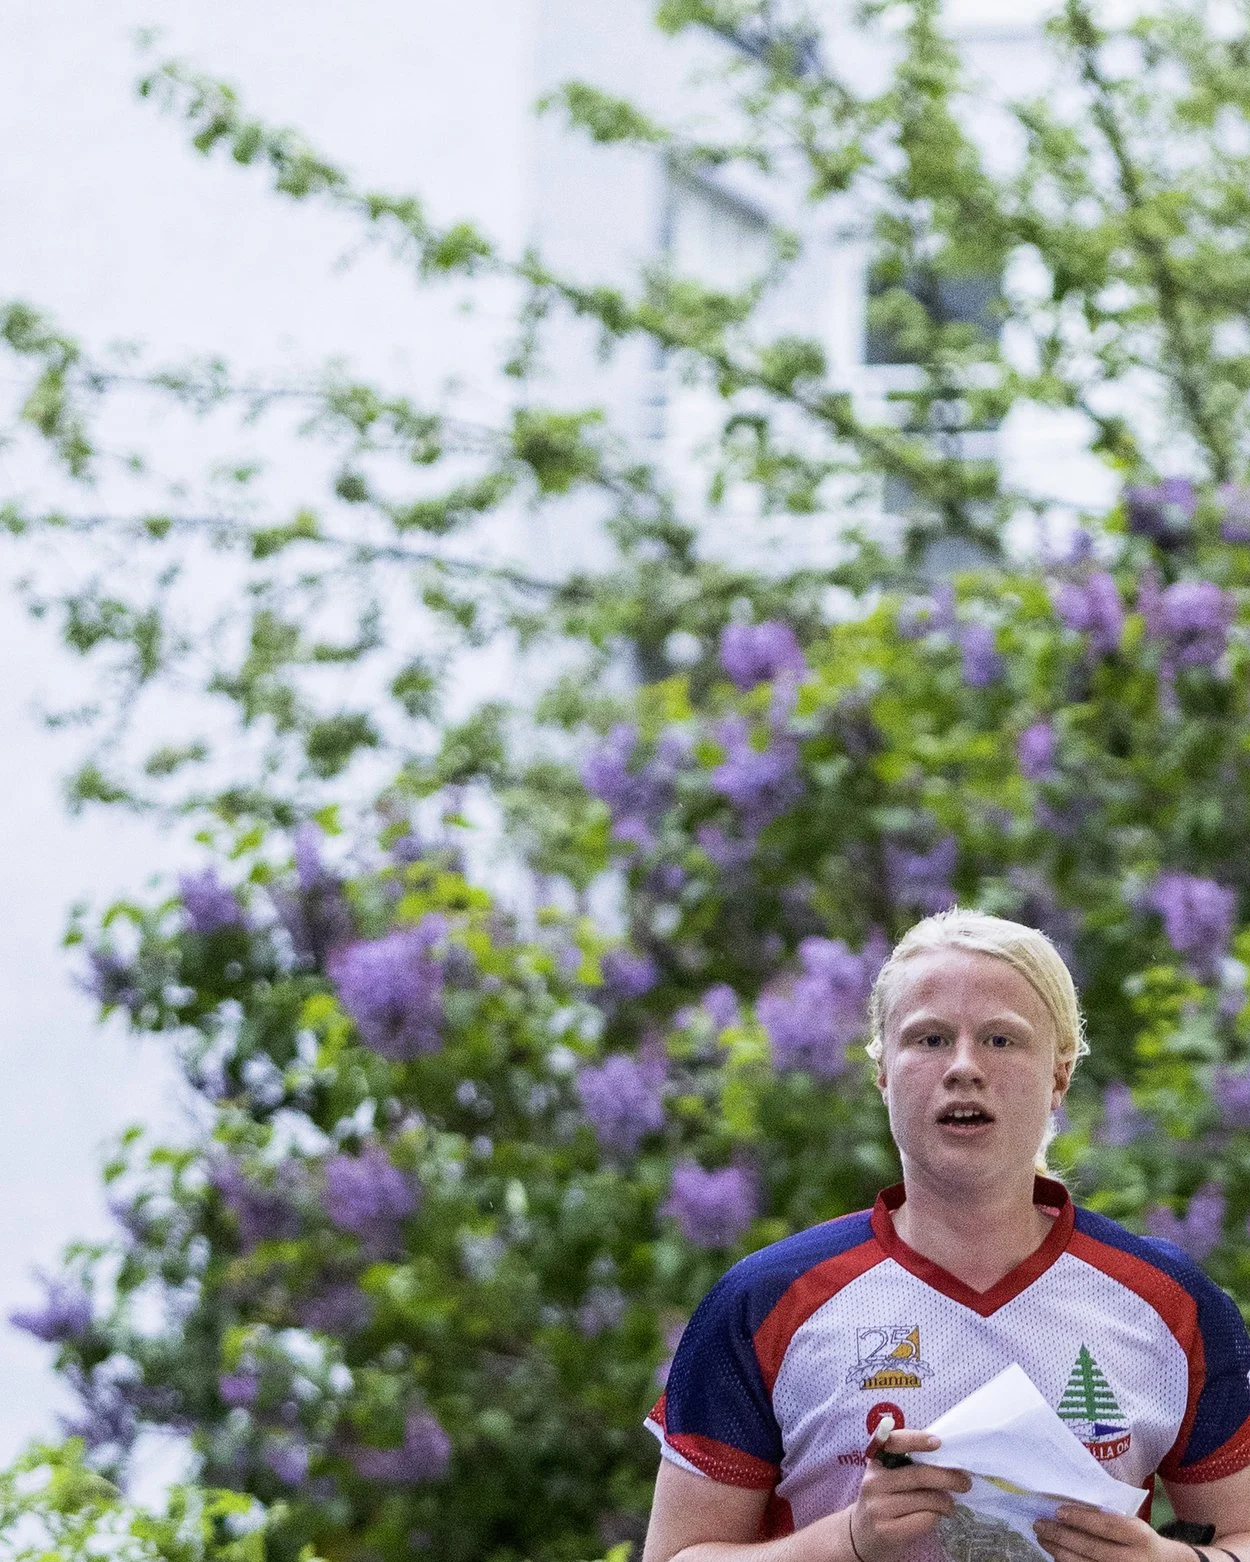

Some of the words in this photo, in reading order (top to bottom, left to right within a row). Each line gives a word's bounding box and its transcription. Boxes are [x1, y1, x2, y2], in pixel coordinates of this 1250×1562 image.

[863, 1375, 918, 1387] manna
[1116, 1438, 1130, 1454] OK
[837, 1450, 868, 1467] mäk
